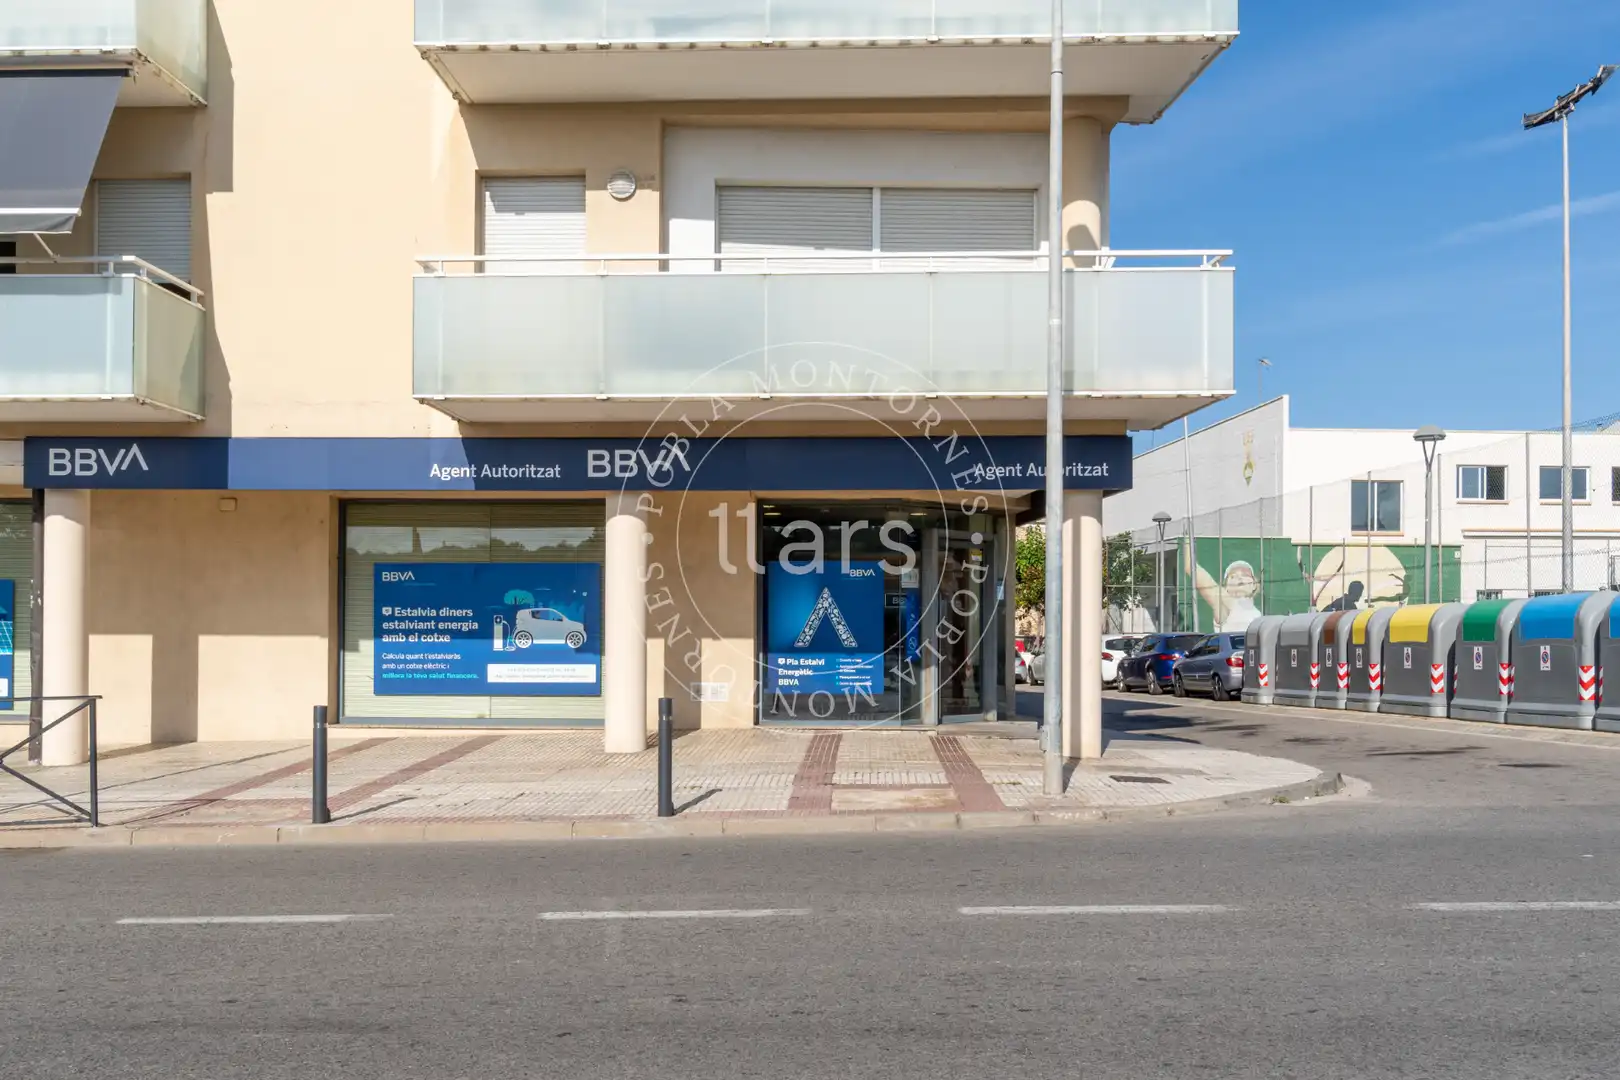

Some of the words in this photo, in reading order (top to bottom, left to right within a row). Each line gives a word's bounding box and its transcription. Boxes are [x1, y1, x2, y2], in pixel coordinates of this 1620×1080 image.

[49, 443, 149, 476] BBVA
[587, 445, 691, 478] BBVA
[430, 463, 477, 481] Agent
[481, 463, 561, 478] Autoritzat
[974, 462, 1023, 480] Agent
[1026, 462, 1109, 477] Auritzat
[382, 571, 415, 582] BBVA
[850, 569, 876, 577] BBVA
[394, 607, 437, 617] Estalvia
[439, 607, 474, 617] diners
[382, 620, 435, 630] estalviant
[438, 620, 479, 631] energia
[382, 632, 406, 642] amb
[408, 632, 418, 642] el
[421, 633, 451, 642] cotxe
[786, 658, 799, 666] Pla
[800, 658, 825, 666] Estalvi
[778, 678, 800, 686] BBVA
